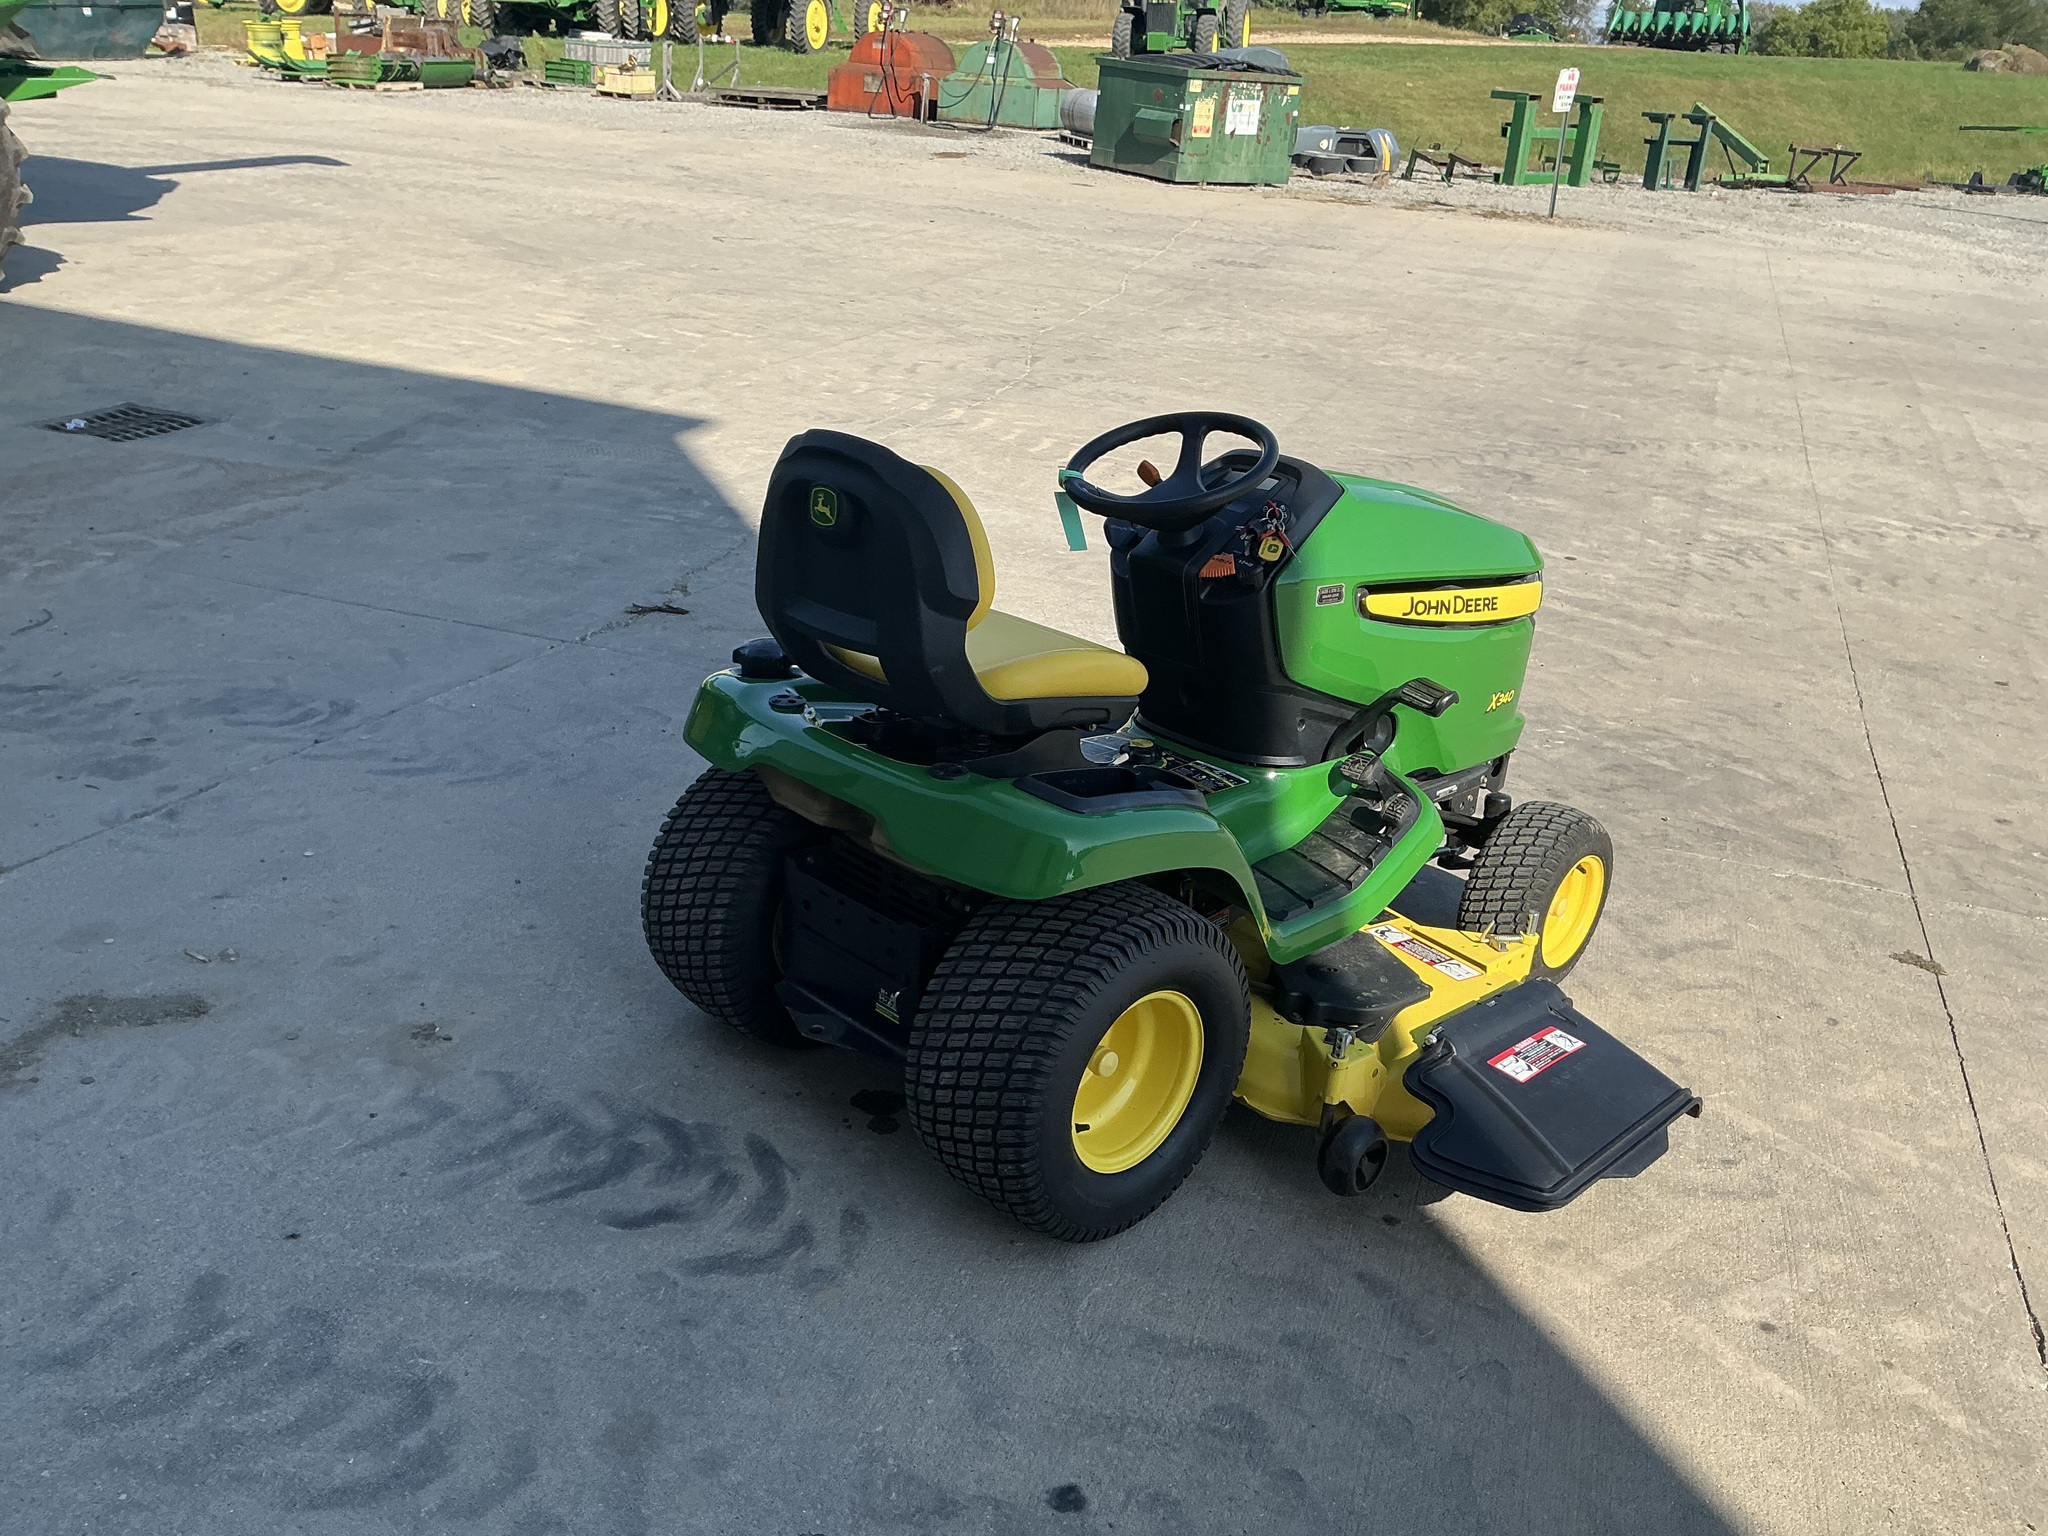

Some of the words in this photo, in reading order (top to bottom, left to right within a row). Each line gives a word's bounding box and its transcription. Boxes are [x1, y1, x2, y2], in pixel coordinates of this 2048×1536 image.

[1402, 596, 1451, 616] JOHN
[1453, 595, 1499, 614] DEERE
[1484, 689, 1515, 714] X340
